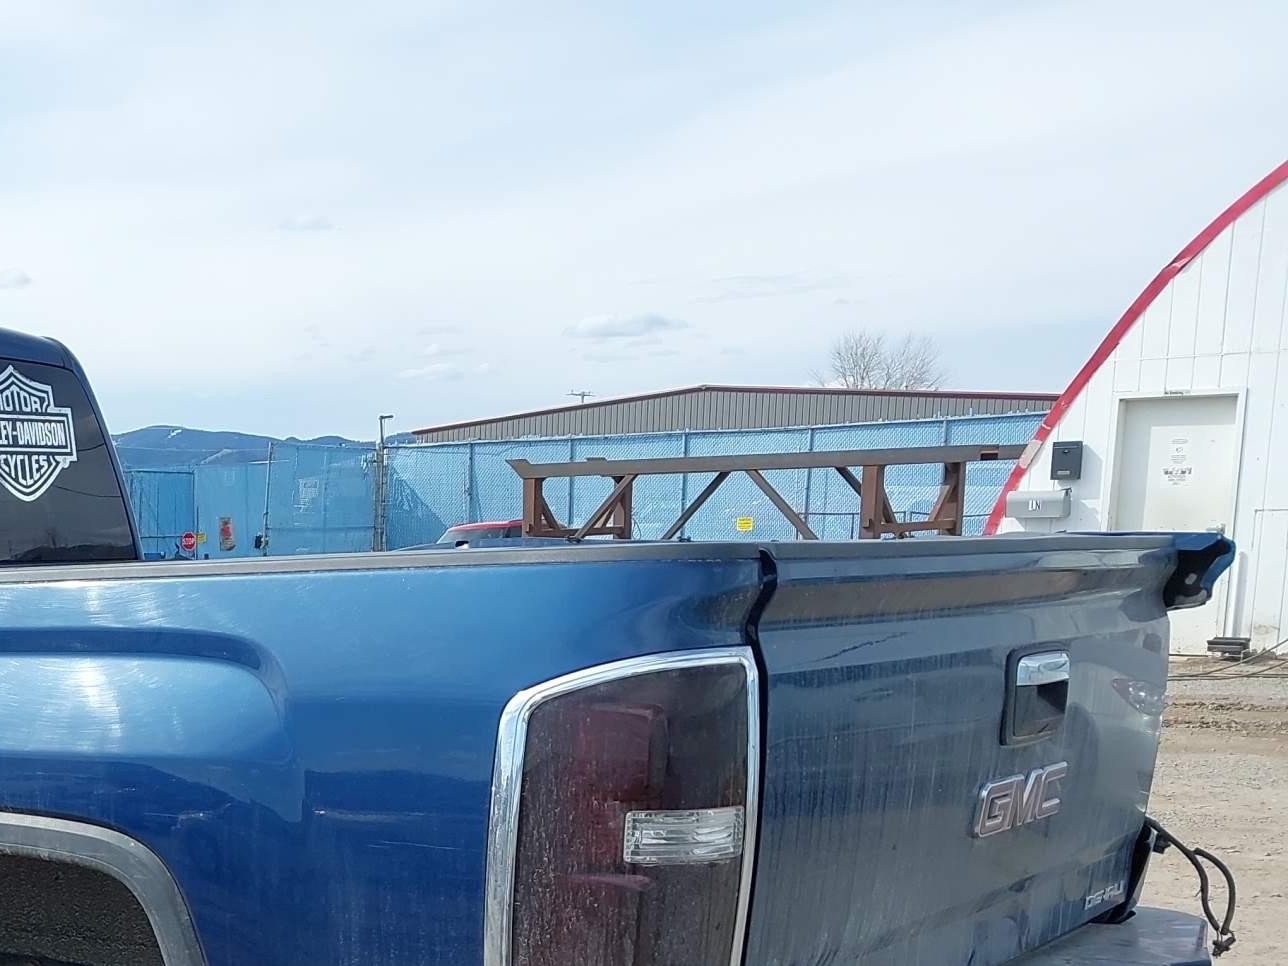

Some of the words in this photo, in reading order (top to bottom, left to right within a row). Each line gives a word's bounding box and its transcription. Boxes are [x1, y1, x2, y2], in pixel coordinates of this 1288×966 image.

[0, 454, 49, 486] CYCLES
[974, 761, 1068, 838] GMC
[1084, 879, 1125, 911] DENALI
